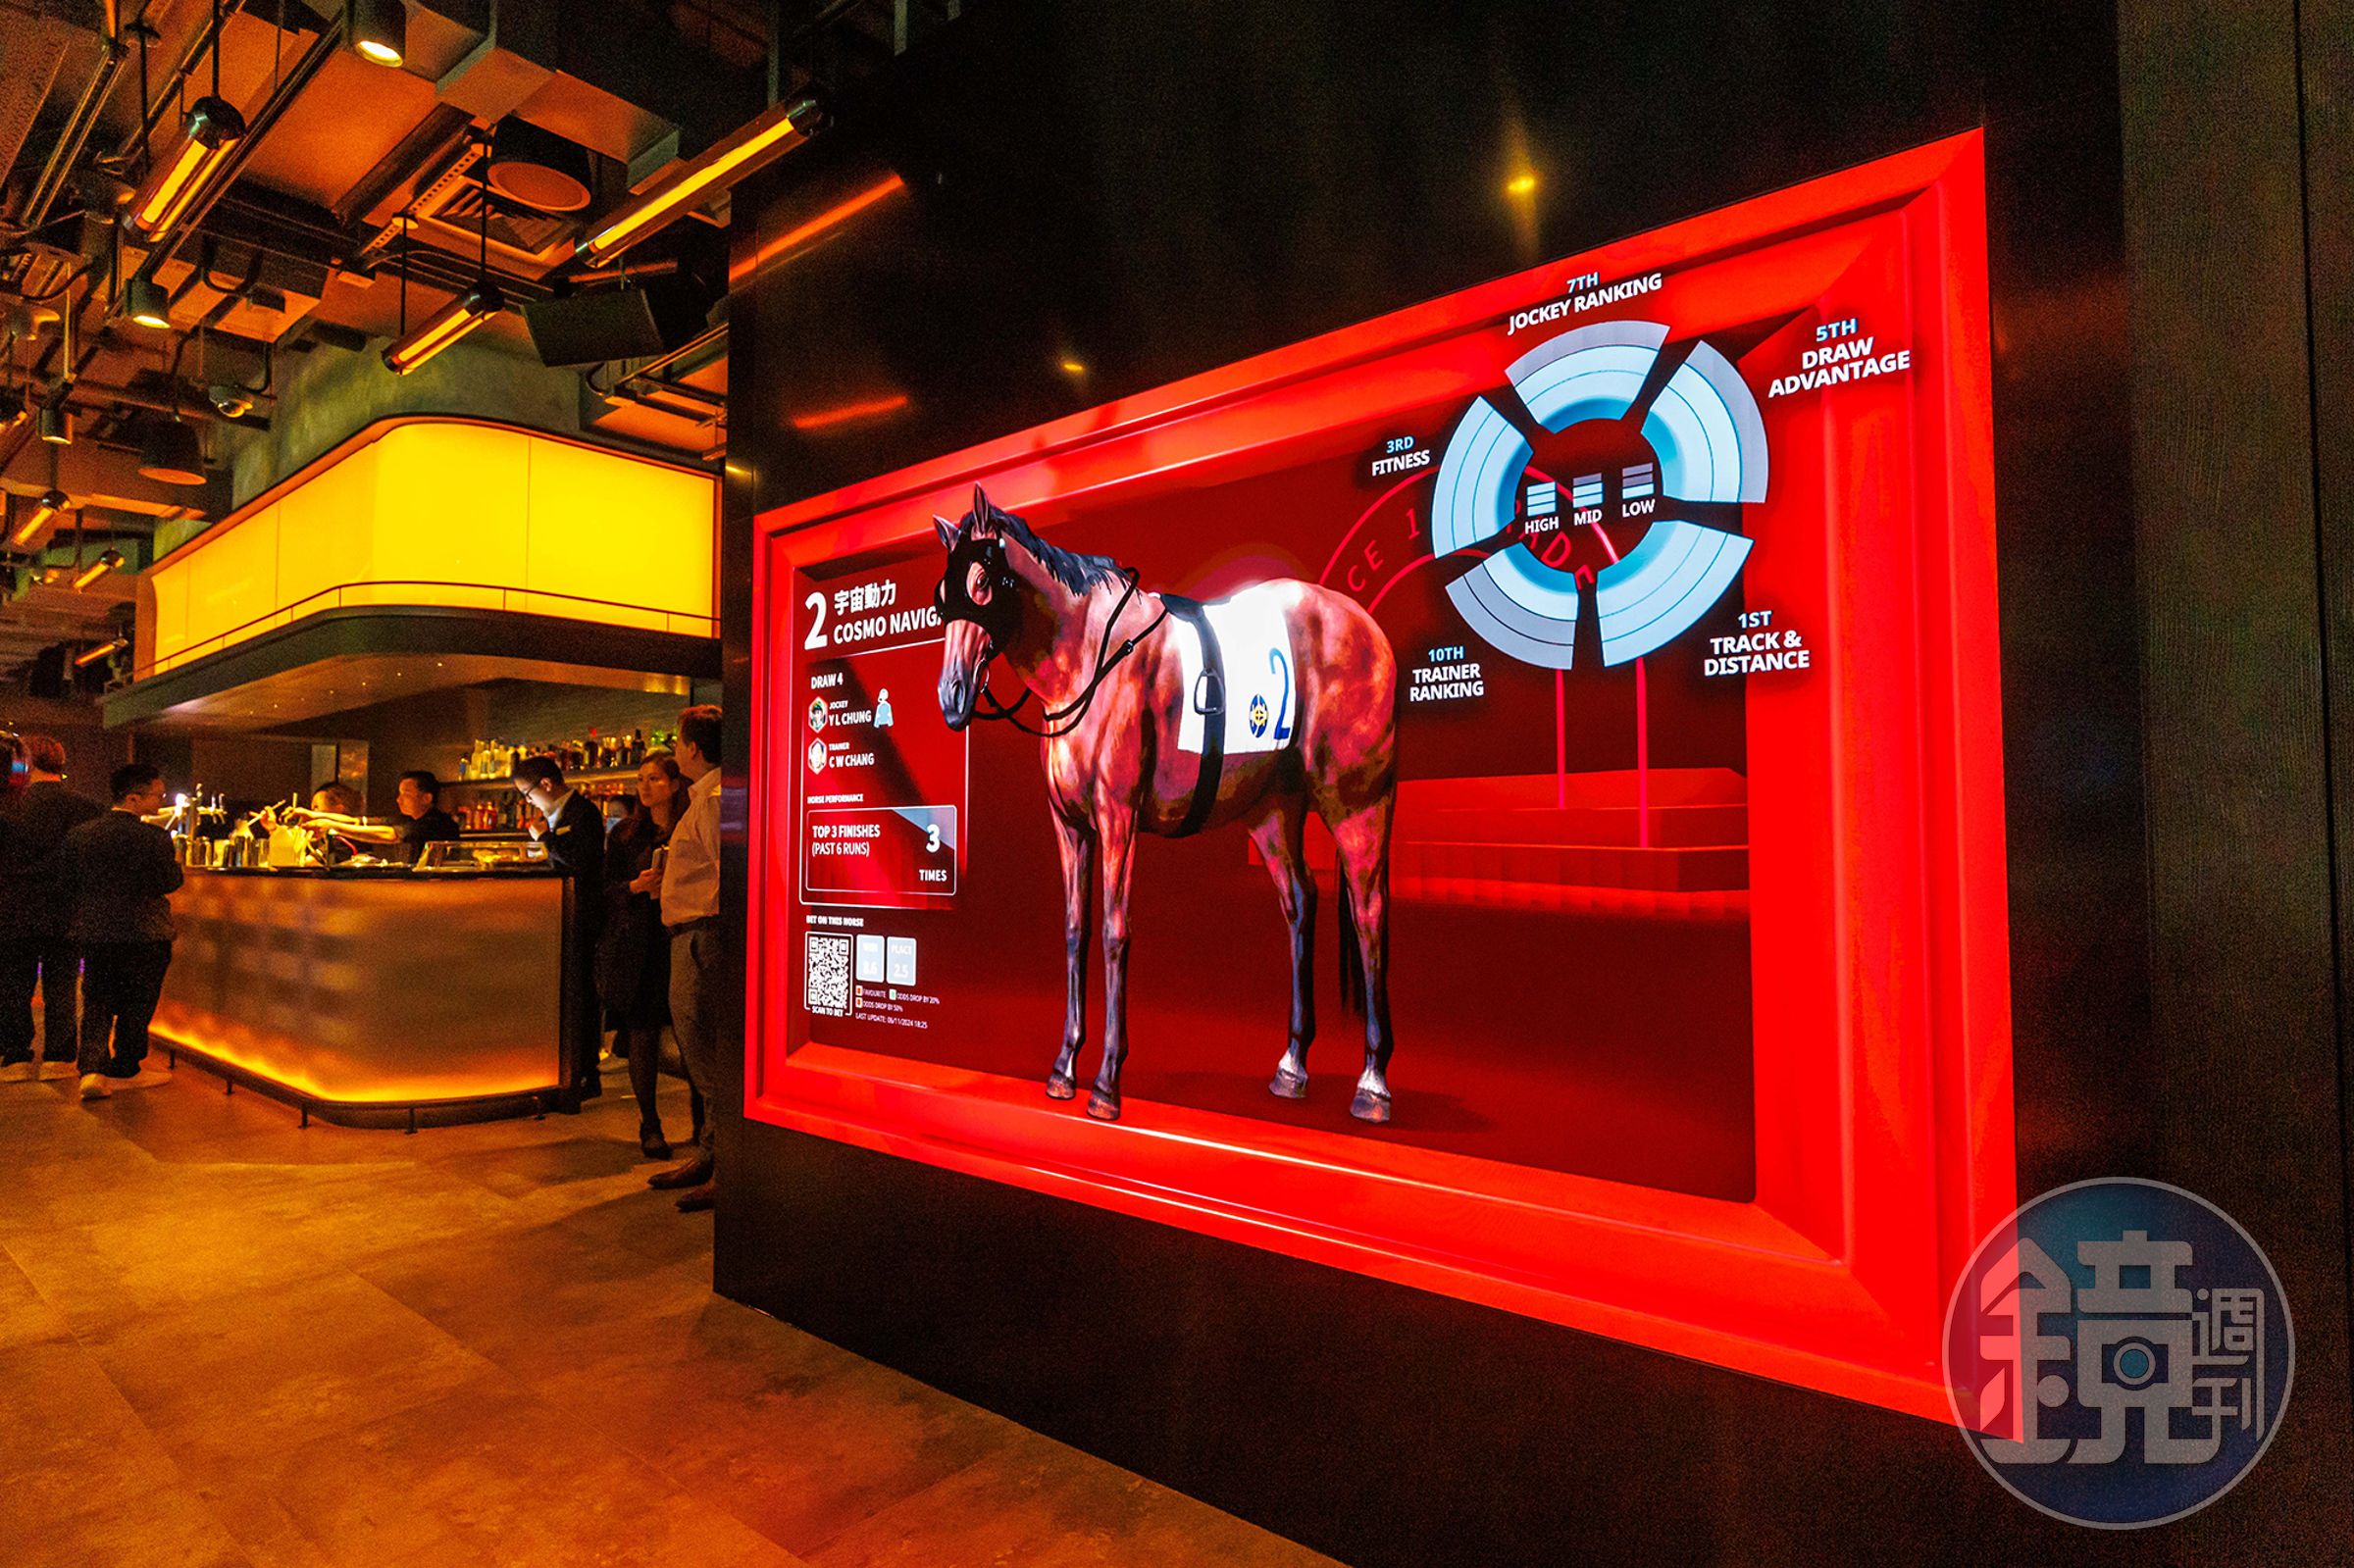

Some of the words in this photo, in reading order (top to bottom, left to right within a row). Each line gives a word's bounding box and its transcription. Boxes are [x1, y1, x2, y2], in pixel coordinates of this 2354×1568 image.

[1566, 272, 1600, 293] 7TH
[1508, 300, 1570, 335] JOCKEY
[1574, 274, 1663, 314] RANKING
[1816, 318, 1858, 342] 5TH
[1802, 336, 1874, 369] DRAW
[1768, 350, 1911, 397] ADVANTAGE
[1386, 435, 1414, 453] 3RD
[1371, 449, 1431, 477] FITNESS
[1524, 516, 1560, 534] HIGH
[1573, 509, 1603, 527] MID
[1621, 499, 1656, 518] LOW
[834, 579, 896, 616] 宇宙動力
[804, 591, 828, 650] 2
[833, 616, 887, 644] COSMO
[890, 605, 942, 634] NAVIG
[1738, 611, 1771, 629] 1ST
[1427, 646, 1464, 661] 10TH
[1710, 632, 1780, 654] TRACK
[1783, 630, 1803, 648] &
[1411, 663, 1481, 684] TRAINER
[1704, 650, 1810, 677] DISTANCE
[810, 673, 837, 689] DRAW
[837, 672, 844, 685] 4
[1409, 680, 1485, 702] RANKING
[1269, 647, 1291, 739] 2
[842, 710, 872, 725] CHUNG
[829, 756, 835, 768] C
[836, 755, 844, 768] W
[844, 752, 875, 767] CHANG
[812, 825, 831, 838] TOP
[832, 825, 838, 837] 3
[839, 824, 881, 837] FINISHES
[925, 824, 941, 853] 3
[812, 842, 836, 857] (PAST
[836, 842, 842, 855] 6
[843, 841, 870, 857] RUNS)
[918, 870, 947, 882] TIMES
